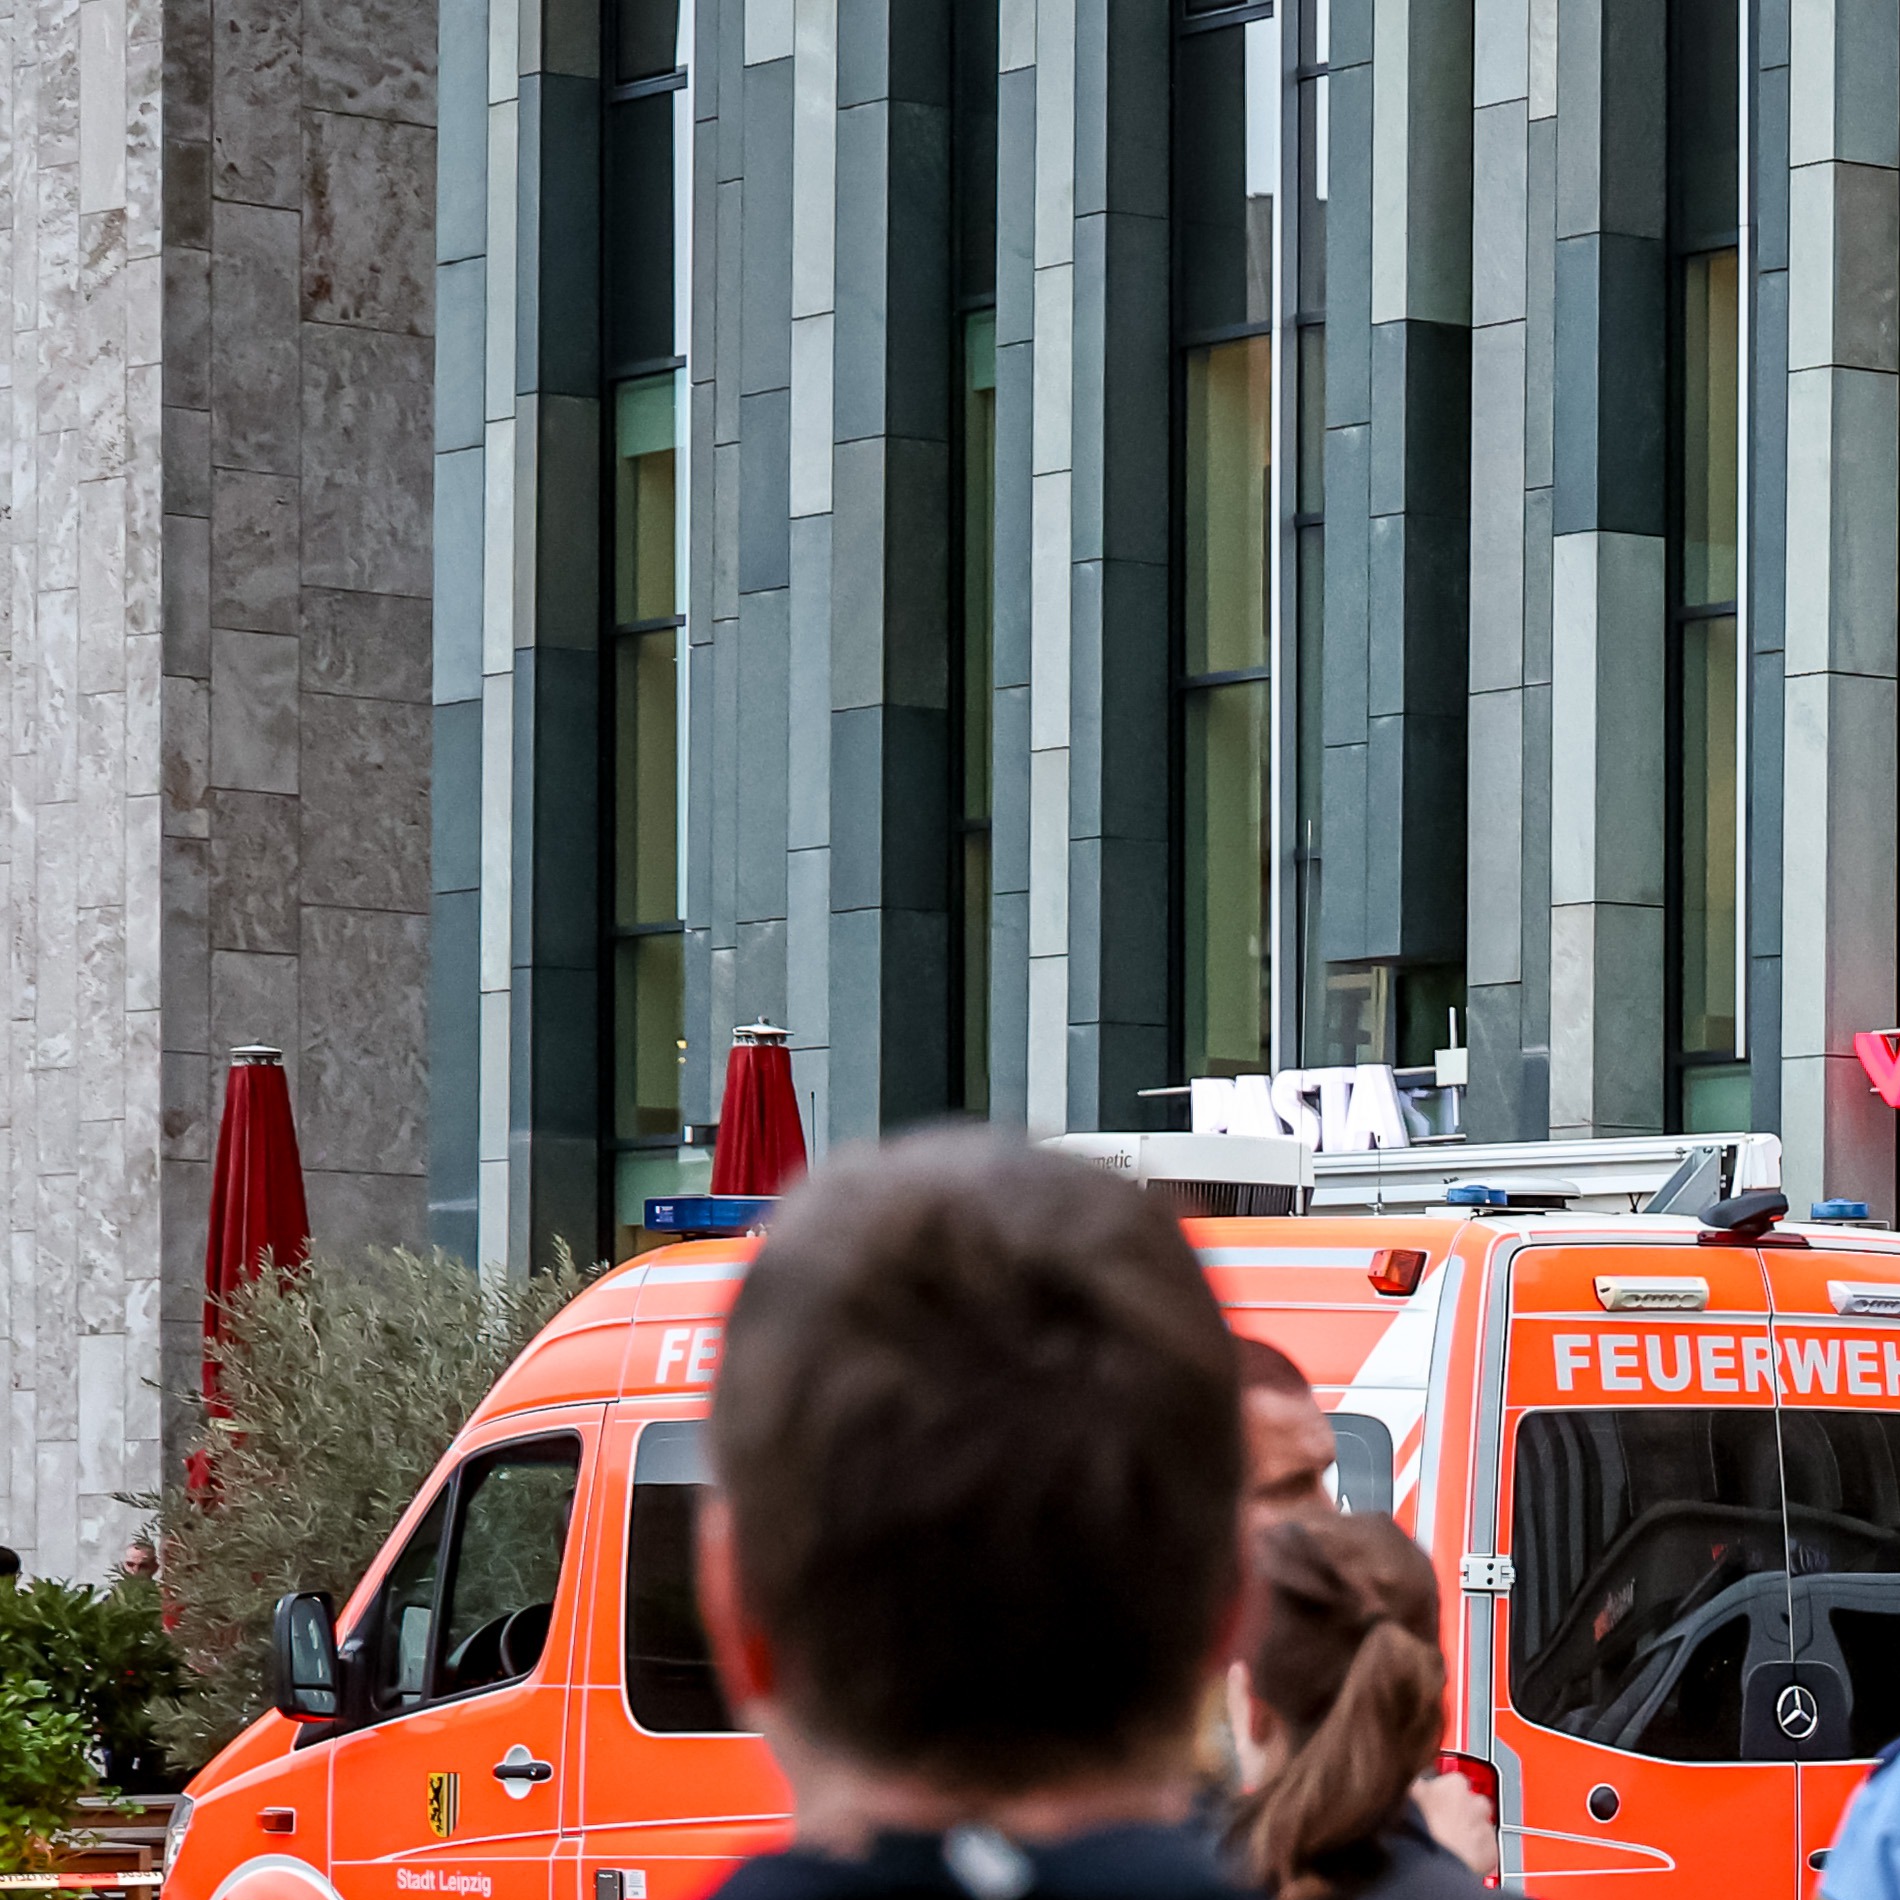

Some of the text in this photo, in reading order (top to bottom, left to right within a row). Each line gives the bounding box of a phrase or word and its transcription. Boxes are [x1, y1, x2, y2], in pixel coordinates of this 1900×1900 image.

[1191, 1064, 1410, 1151] PASTA
[397, 1868, 492, 1898] Stadt Leipzig
